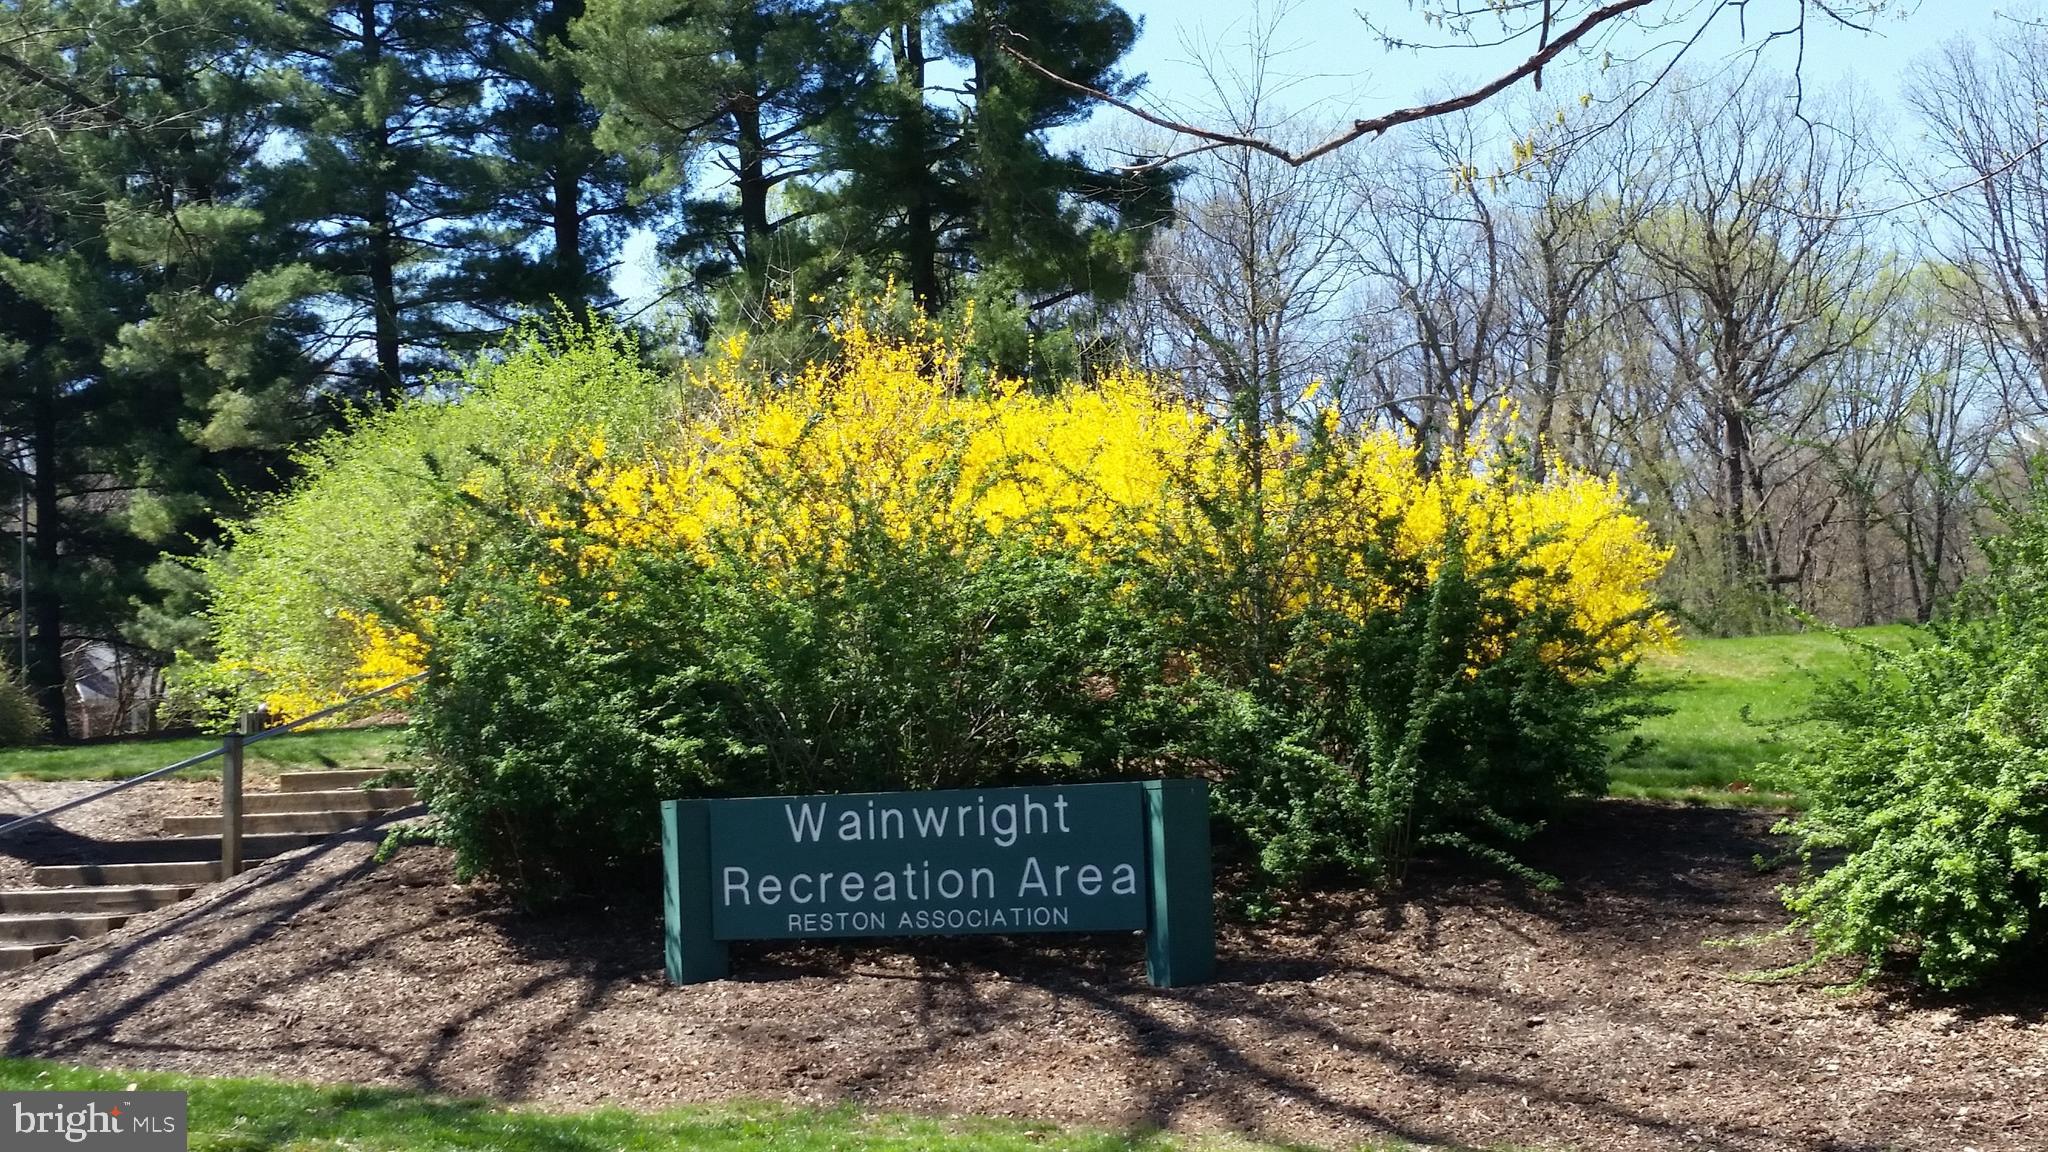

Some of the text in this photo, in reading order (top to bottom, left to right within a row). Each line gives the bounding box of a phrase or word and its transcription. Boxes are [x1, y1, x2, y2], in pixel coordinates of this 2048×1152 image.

[785, 793, 1070, 847] Wainwright
[723, 856, 1137, 906] Recreation Area
[788, 906, 1069, 932] RESTON ASSOCIATION
